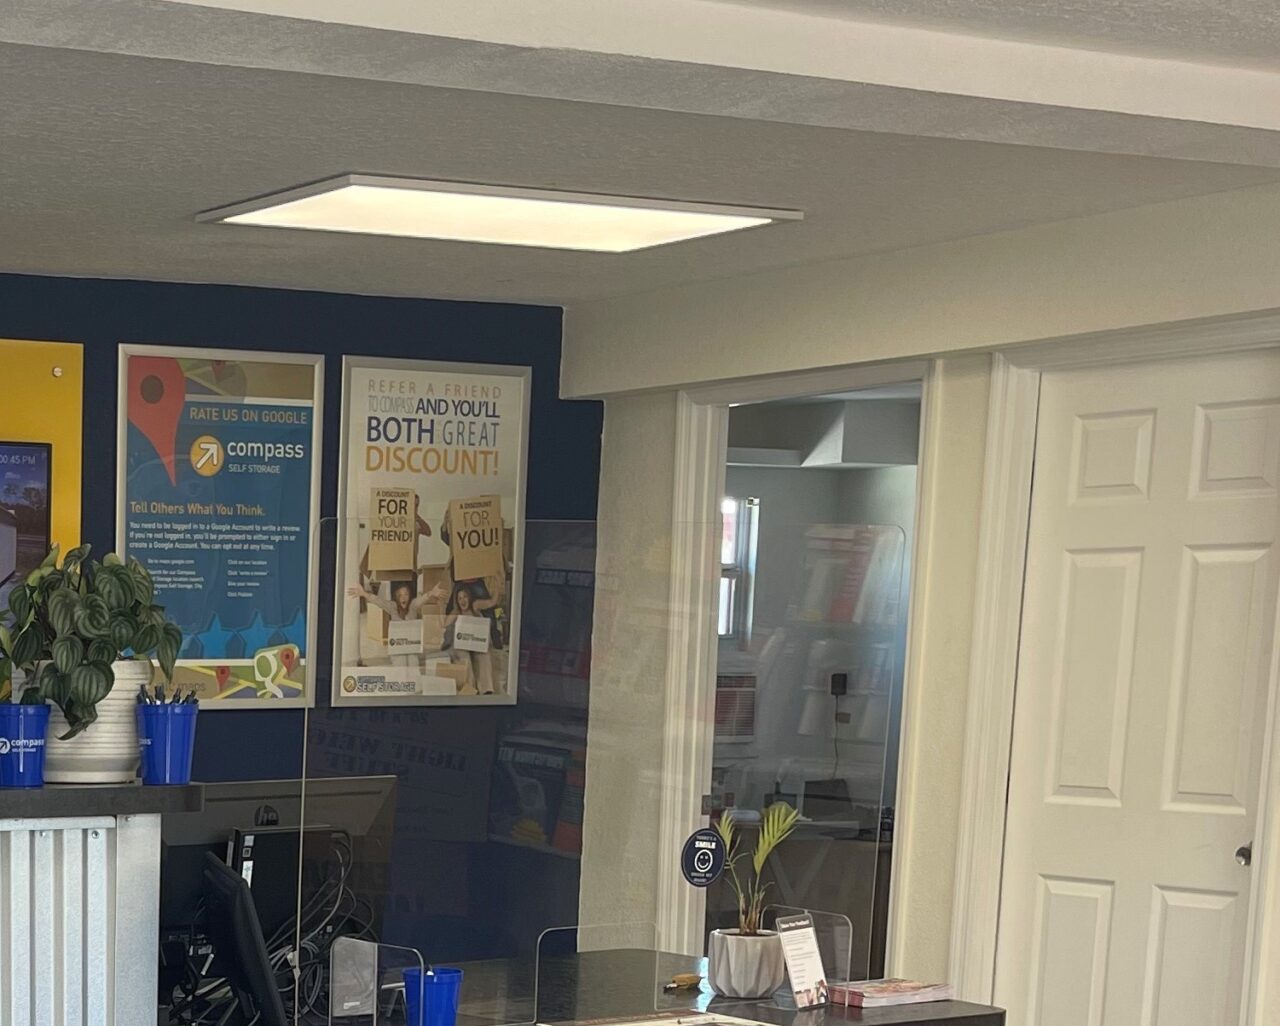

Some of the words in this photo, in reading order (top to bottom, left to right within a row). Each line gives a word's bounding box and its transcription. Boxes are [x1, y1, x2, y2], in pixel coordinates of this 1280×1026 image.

[368, 379, 416, 394] REFER
[426, 383, 434, 395] A
[445, 384, 501, 399] FRIEND
[190, 407, 219, 420] RATE
[222, 408, 238, 421] US
[242, 409, 258, 422] ON
[262, 411, 307, 424] GOOGLE
[416, 398, 448, 415] AND
[452, 400, 500, 418] YOU'LL
[367, 416, 434, 444] BOTH
[443, 420, 500, 447] GREAT
[227, 442, 304, 461] compass
[228, 464, 246, 473] SELF
[248, 464, 280, 473] STORAGE
[365, 445, 499, 476] DISCOUNT!
[130, 501, 148, 513] Tell
[150, 502, 185, 514] Others
[187, 503, 213, 515] What
[215, 504, 233, 515] You
[236, 504, 266, 516] Think.
[378, 499, 408, 515] FOR
[378, 516, 406, 529] YOUR
[463, 511, 489, 527] FOR
[371, 530, 413, 542] FRIEND!
[457, 528, 499, 549] YOU!
[357, 682, 378, 692] SELF
[378, 682, 416, 693] STORAGE
[695, 841, 716, 849] SMILE
